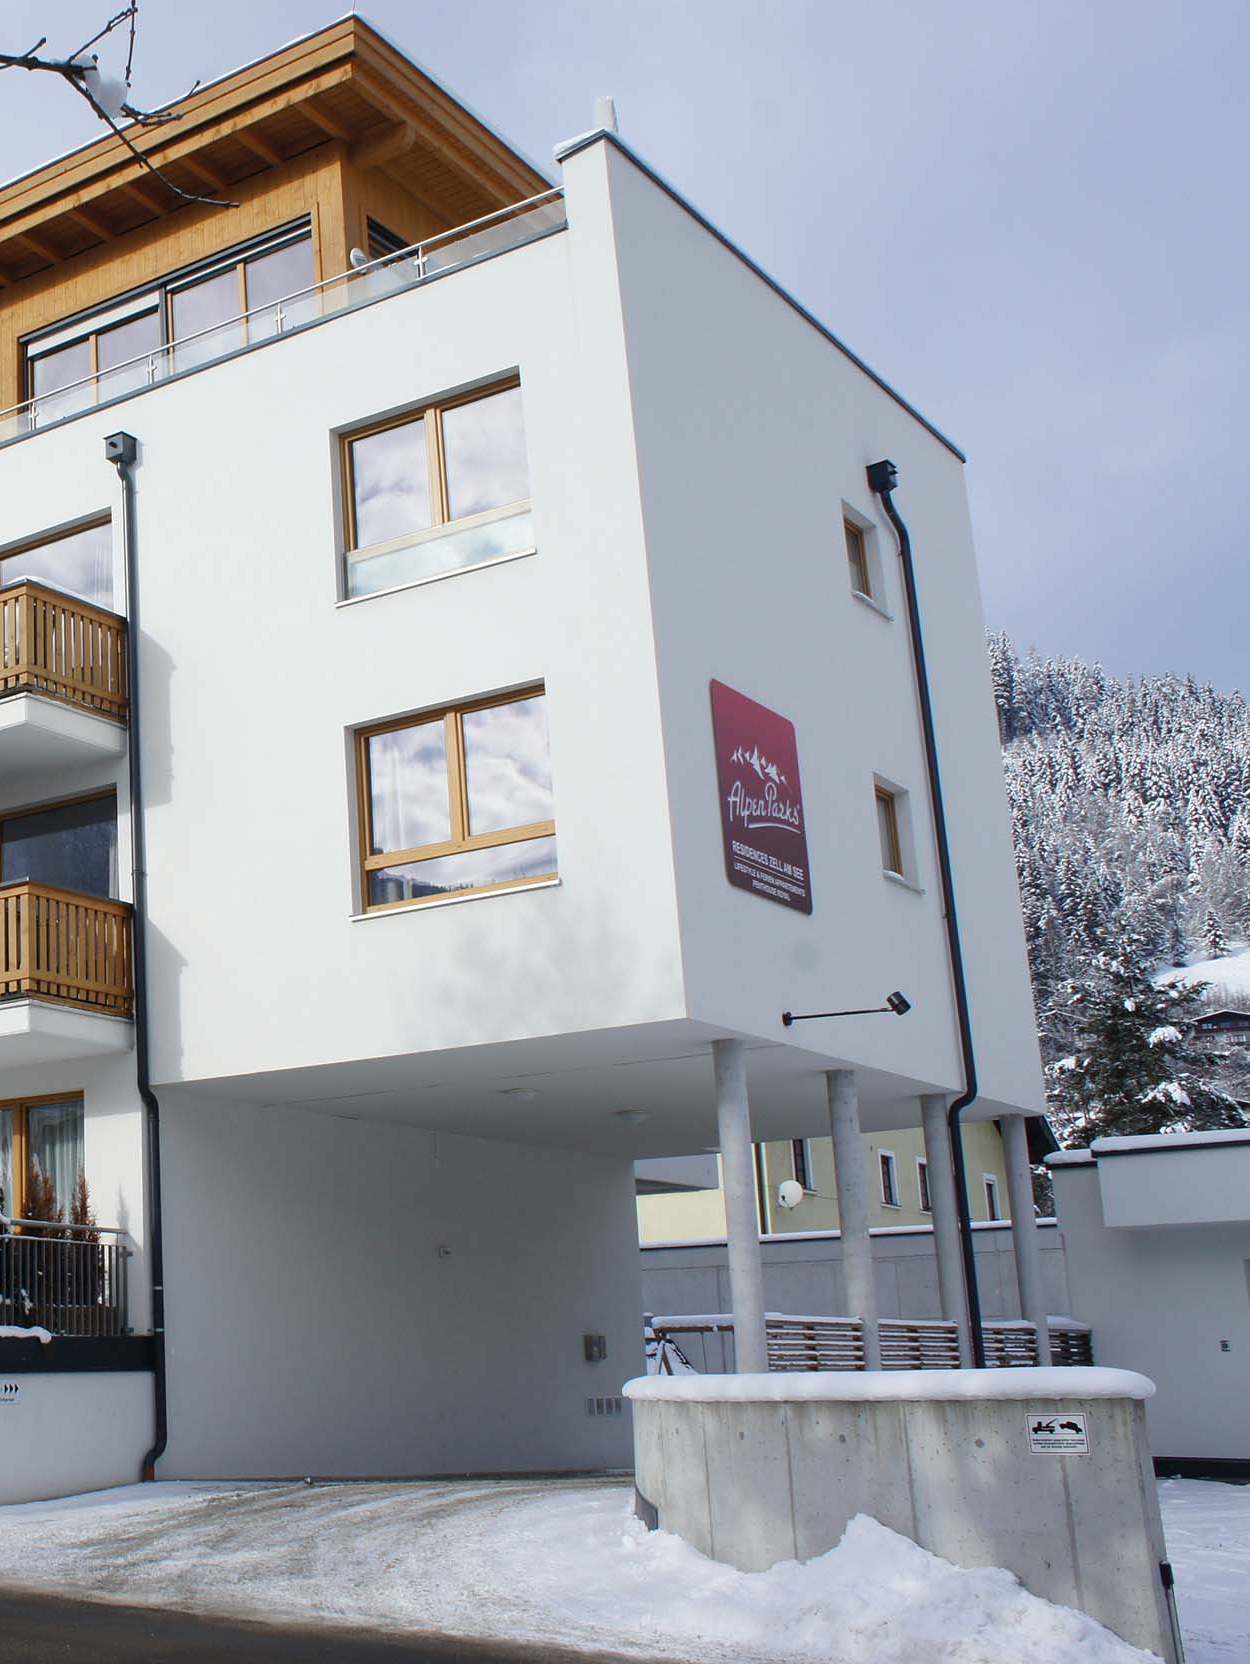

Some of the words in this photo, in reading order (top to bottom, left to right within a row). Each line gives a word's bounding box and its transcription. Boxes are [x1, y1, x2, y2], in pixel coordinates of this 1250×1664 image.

[732, 840, 768, 865] RESIDENCES
[769, 856, 783, 872] ZELL
[783, 863, 792, 875] AM
[792, 866, 803, 880] SEE
